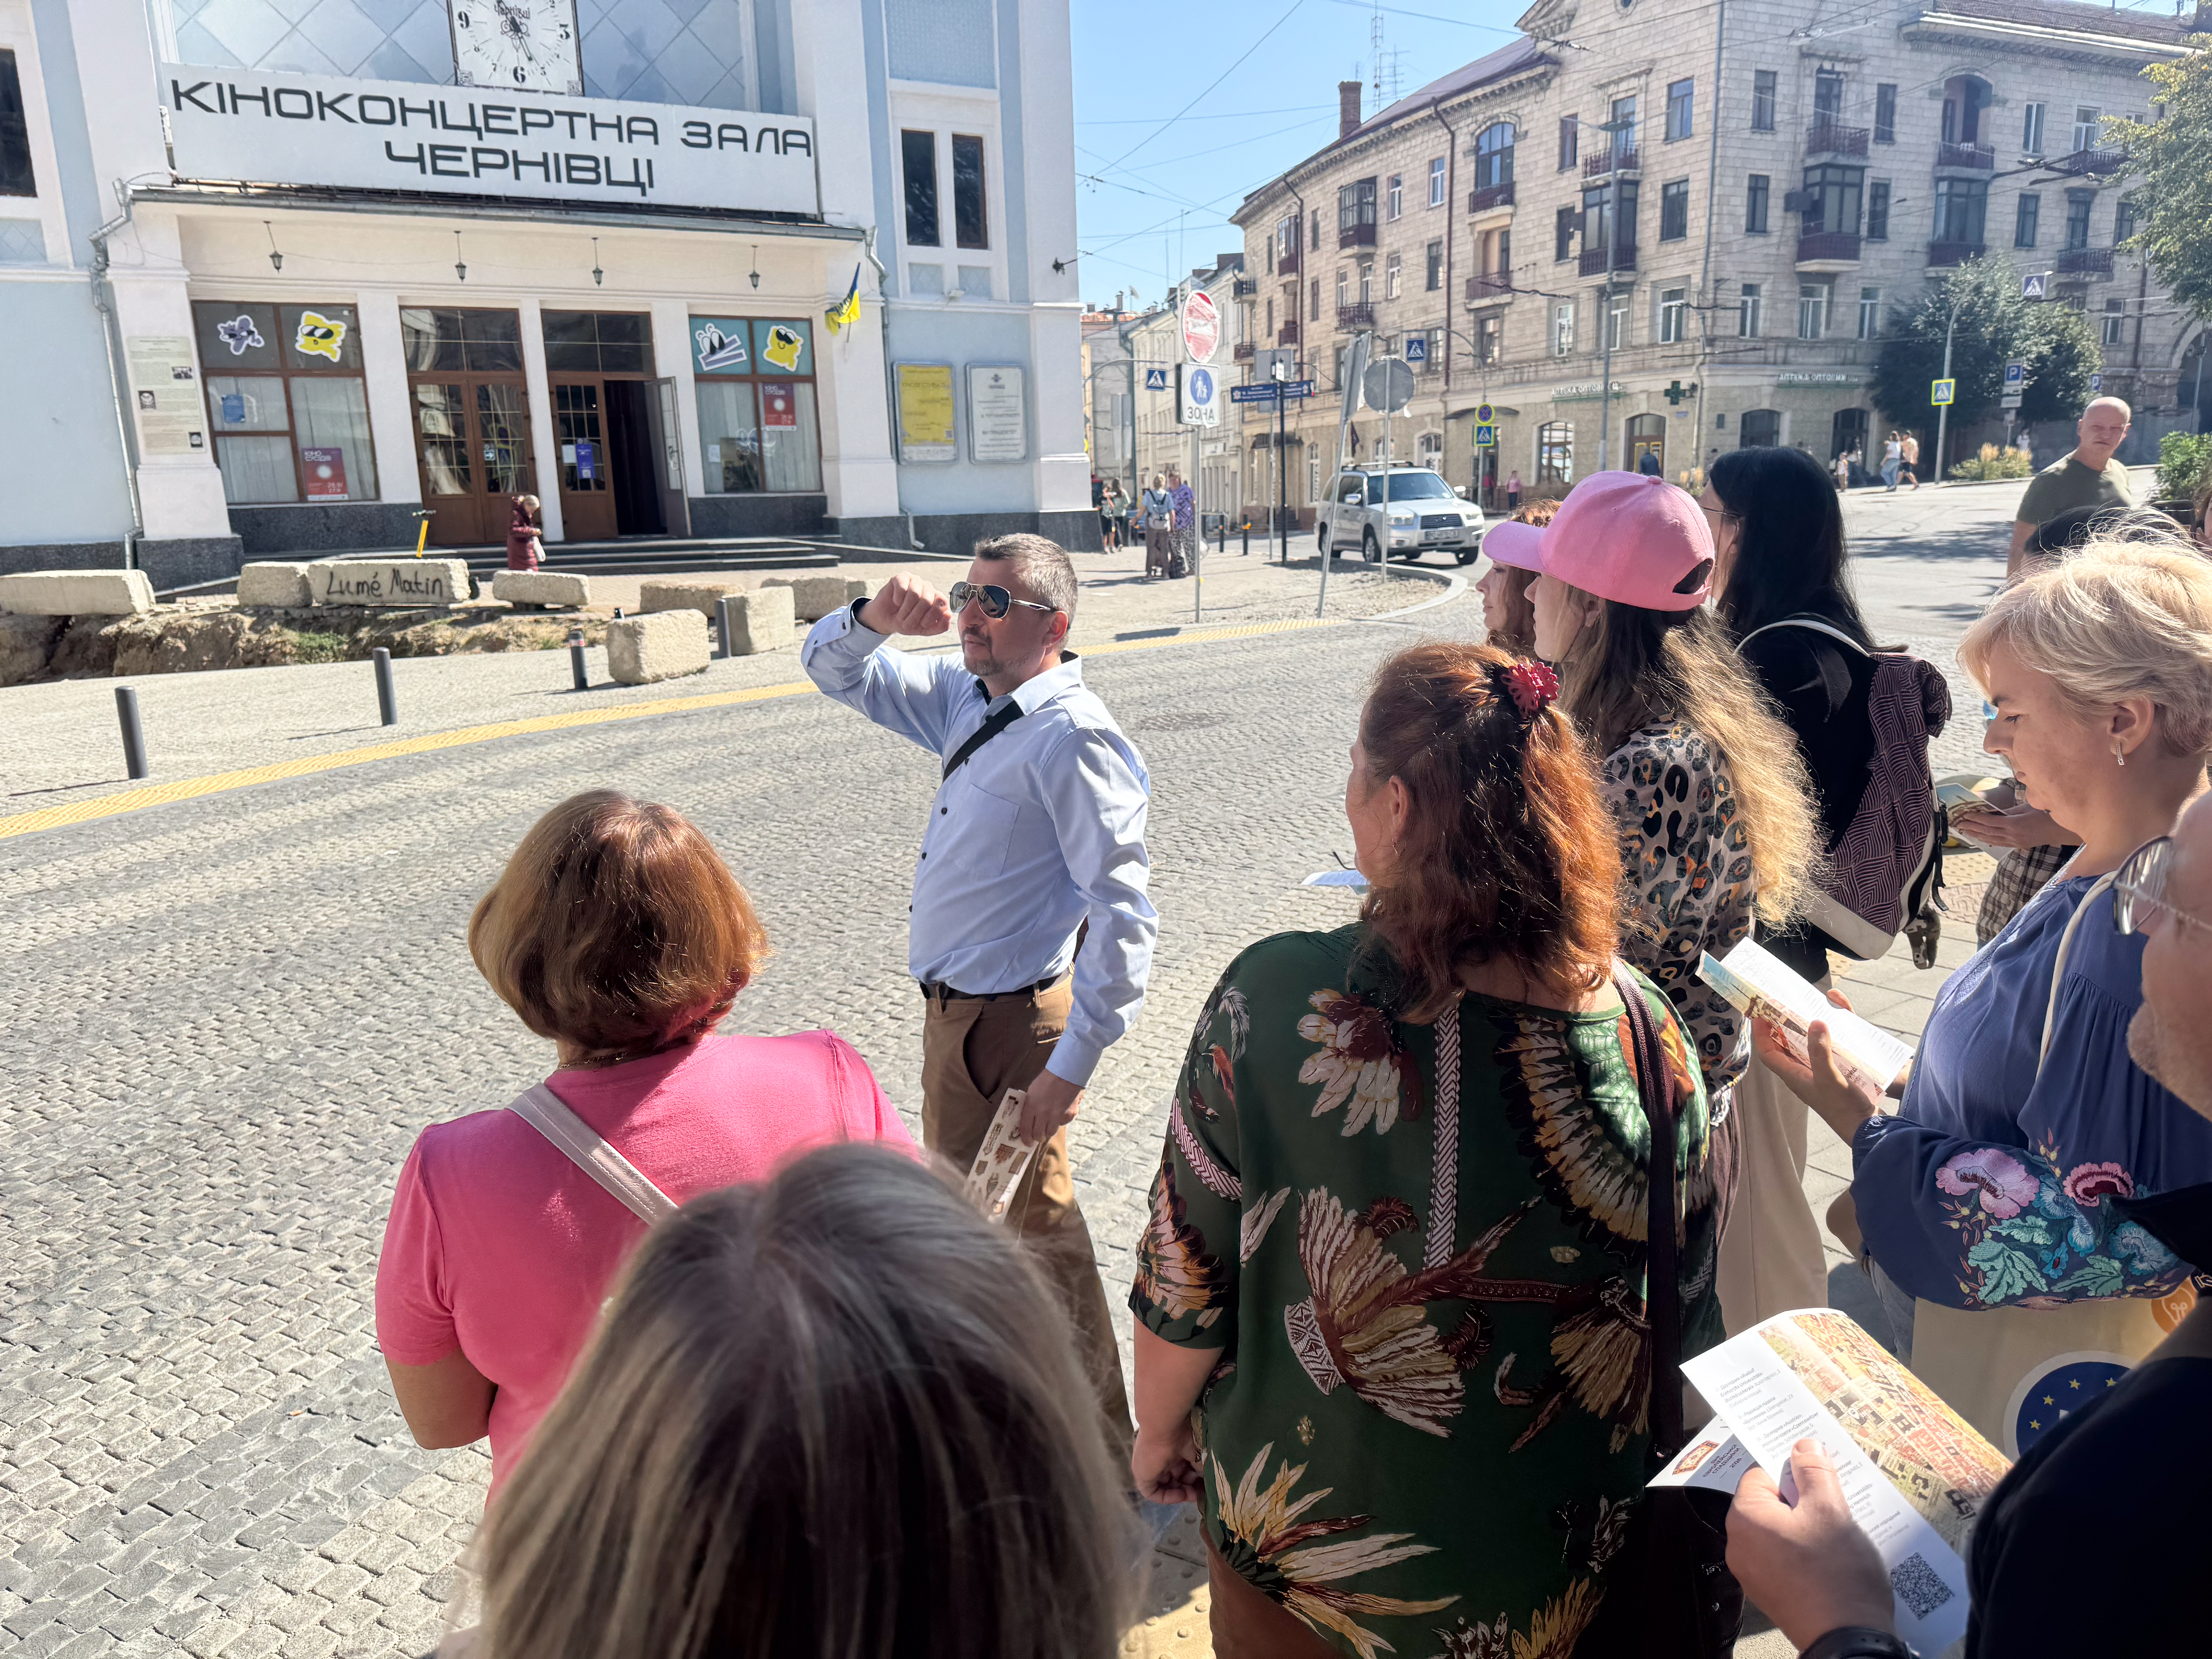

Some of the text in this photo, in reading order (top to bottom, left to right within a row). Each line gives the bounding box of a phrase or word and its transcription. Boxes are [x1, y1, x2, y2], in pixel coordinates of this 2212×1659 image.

[458, 11, 469, 29] 9
[559, 23, 570, 40] 3
[513, 66, 526, 83] 6
[172, 79, 812, 157] КІНОКОНЦЕРТНА ЗАЛА
[385, 141, 654, 197] ЧЕРНІВЦІ
[2010, 367, 2018, 378] P
[1187, 407, 1215, 421] ЗОНА
[327, 568, 443, 597] Lumé Matin
